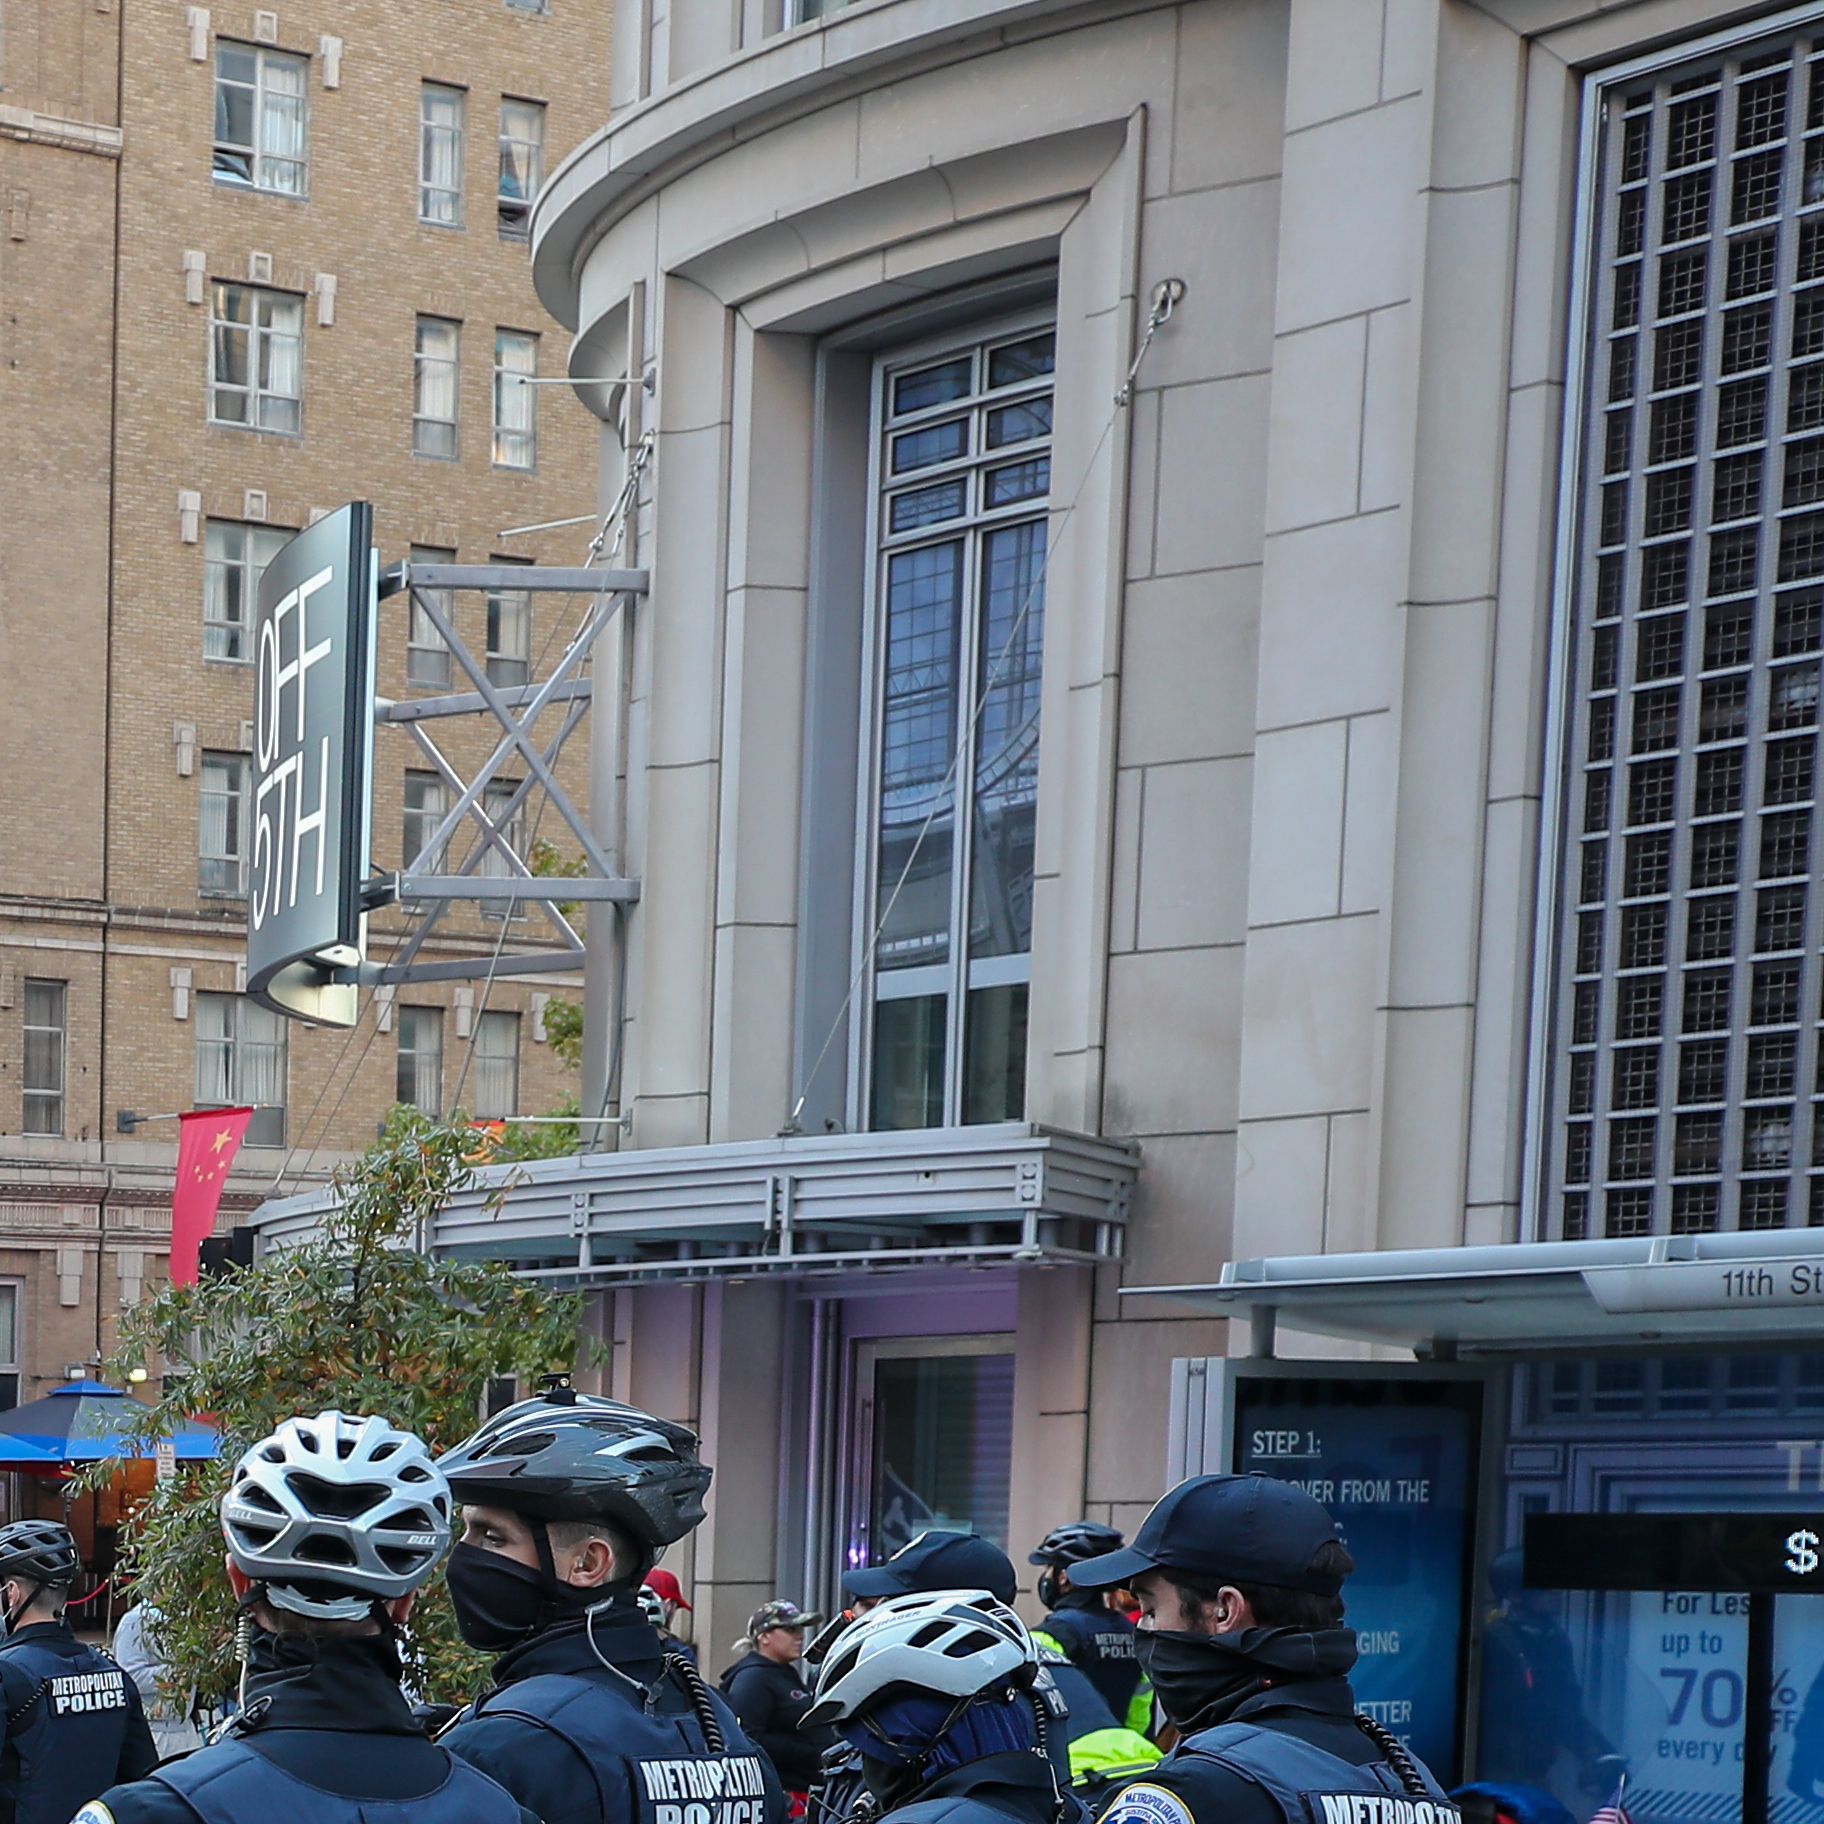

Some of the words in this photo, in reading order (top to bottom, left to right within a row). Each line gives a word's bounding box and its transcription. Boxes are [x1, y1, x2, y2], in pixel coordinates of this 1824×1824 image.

[257, 565, 333, 773] OFF
[253, 736, 330, 931] 5TH
[1722, 1268, 1773, 1297] 11th
[1791, 1265, 1823, 1295] St
[1252, 1430, 1300, 1454] STEP
[1307, 1430, 1321, 1453] 1:
[1341, 1480, 1391, 1502] FROM
[1397, 1480, 1430, 1502] THE
[229, 1510, 252, 1520] BELL
[407, 1535, 438, 1545] BELL
[1663, 1591, 1701, 1615] For
[1711, 1591, 1750, 1615] Les
[1662, 1633, 1690, 1658] up
[1699, 1630, 1723, 1654] to
[52, 1671, 124, 1696] METROPOLITAN
[56, 1690, 126, 1714] POLICE
[1354, 1700, 1412, 1723] ETTER
[1771, 1709, 1798, 1732] FF
[1657, 1738, 1725, 1765] every
[1126, 1793, 1176, 1820] METROPOLITAN
